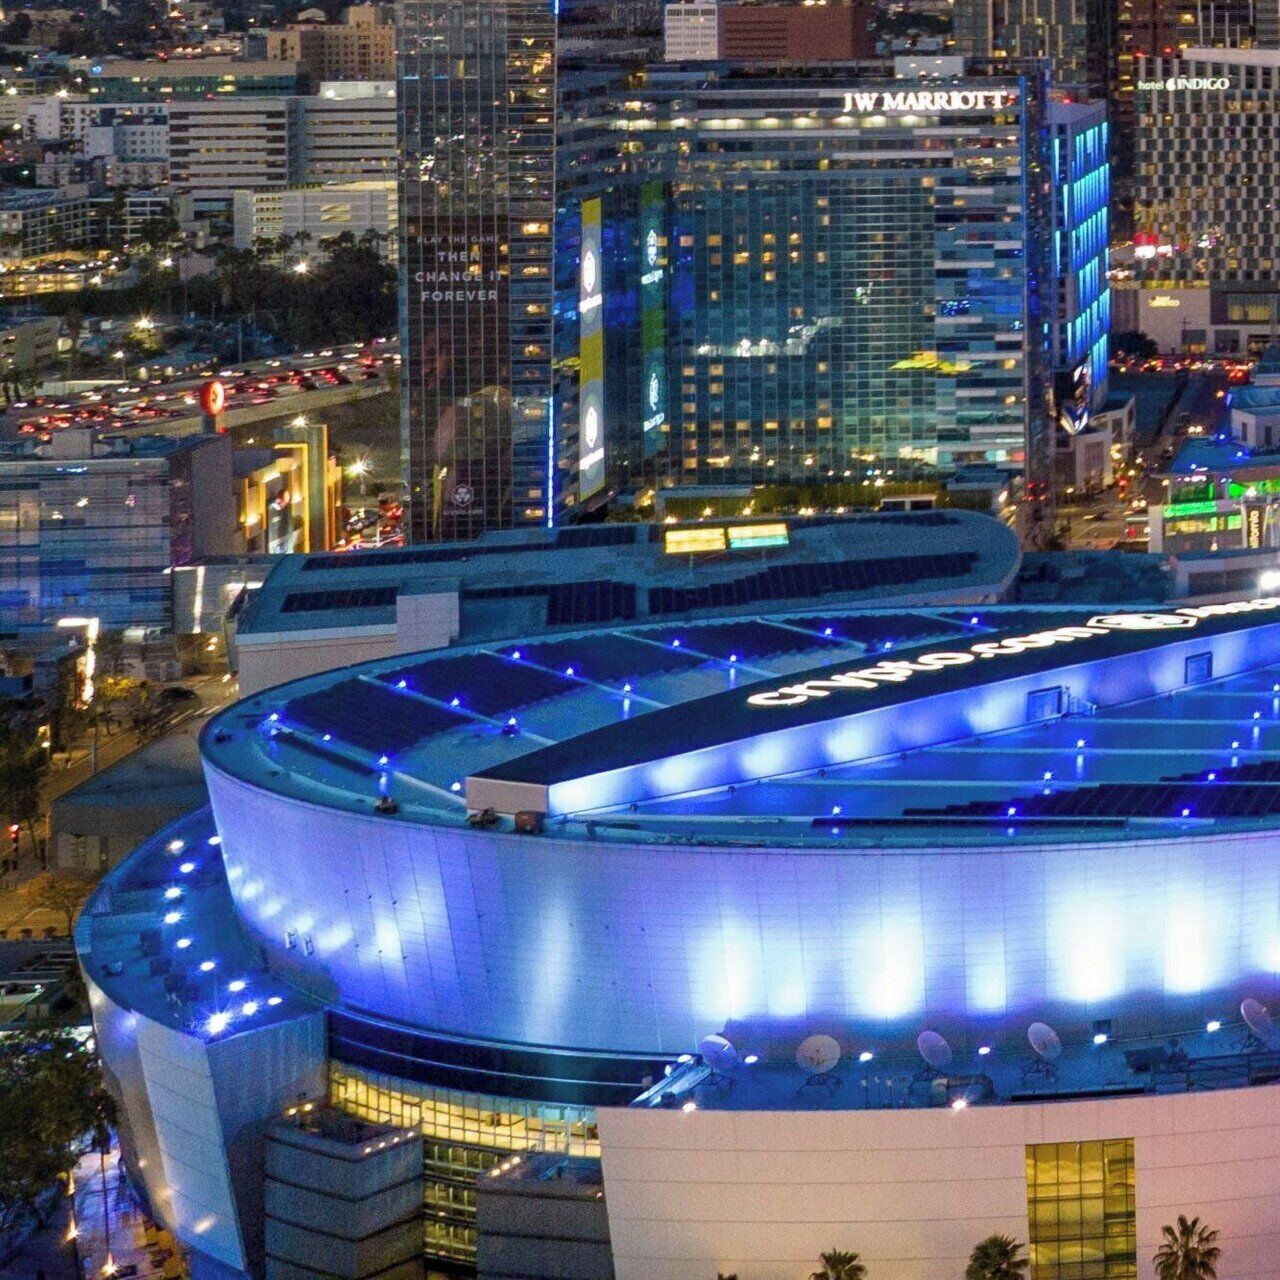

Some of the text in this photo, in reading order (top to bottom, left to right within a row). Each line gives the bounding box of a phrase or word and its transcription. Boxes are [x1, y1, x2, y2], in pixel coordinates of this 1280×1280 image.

[1137, 78, 1230, 91] hotel INDIGO
[842, 90, 1007, 112] JW MARRIOTT
[437, 251, 480, 262] THEN
[415, 271, 503, 282] CHANGE IT
[421, 290, 498, 302] FOREVER
[747, 625, 1110, 706] crypto.com
